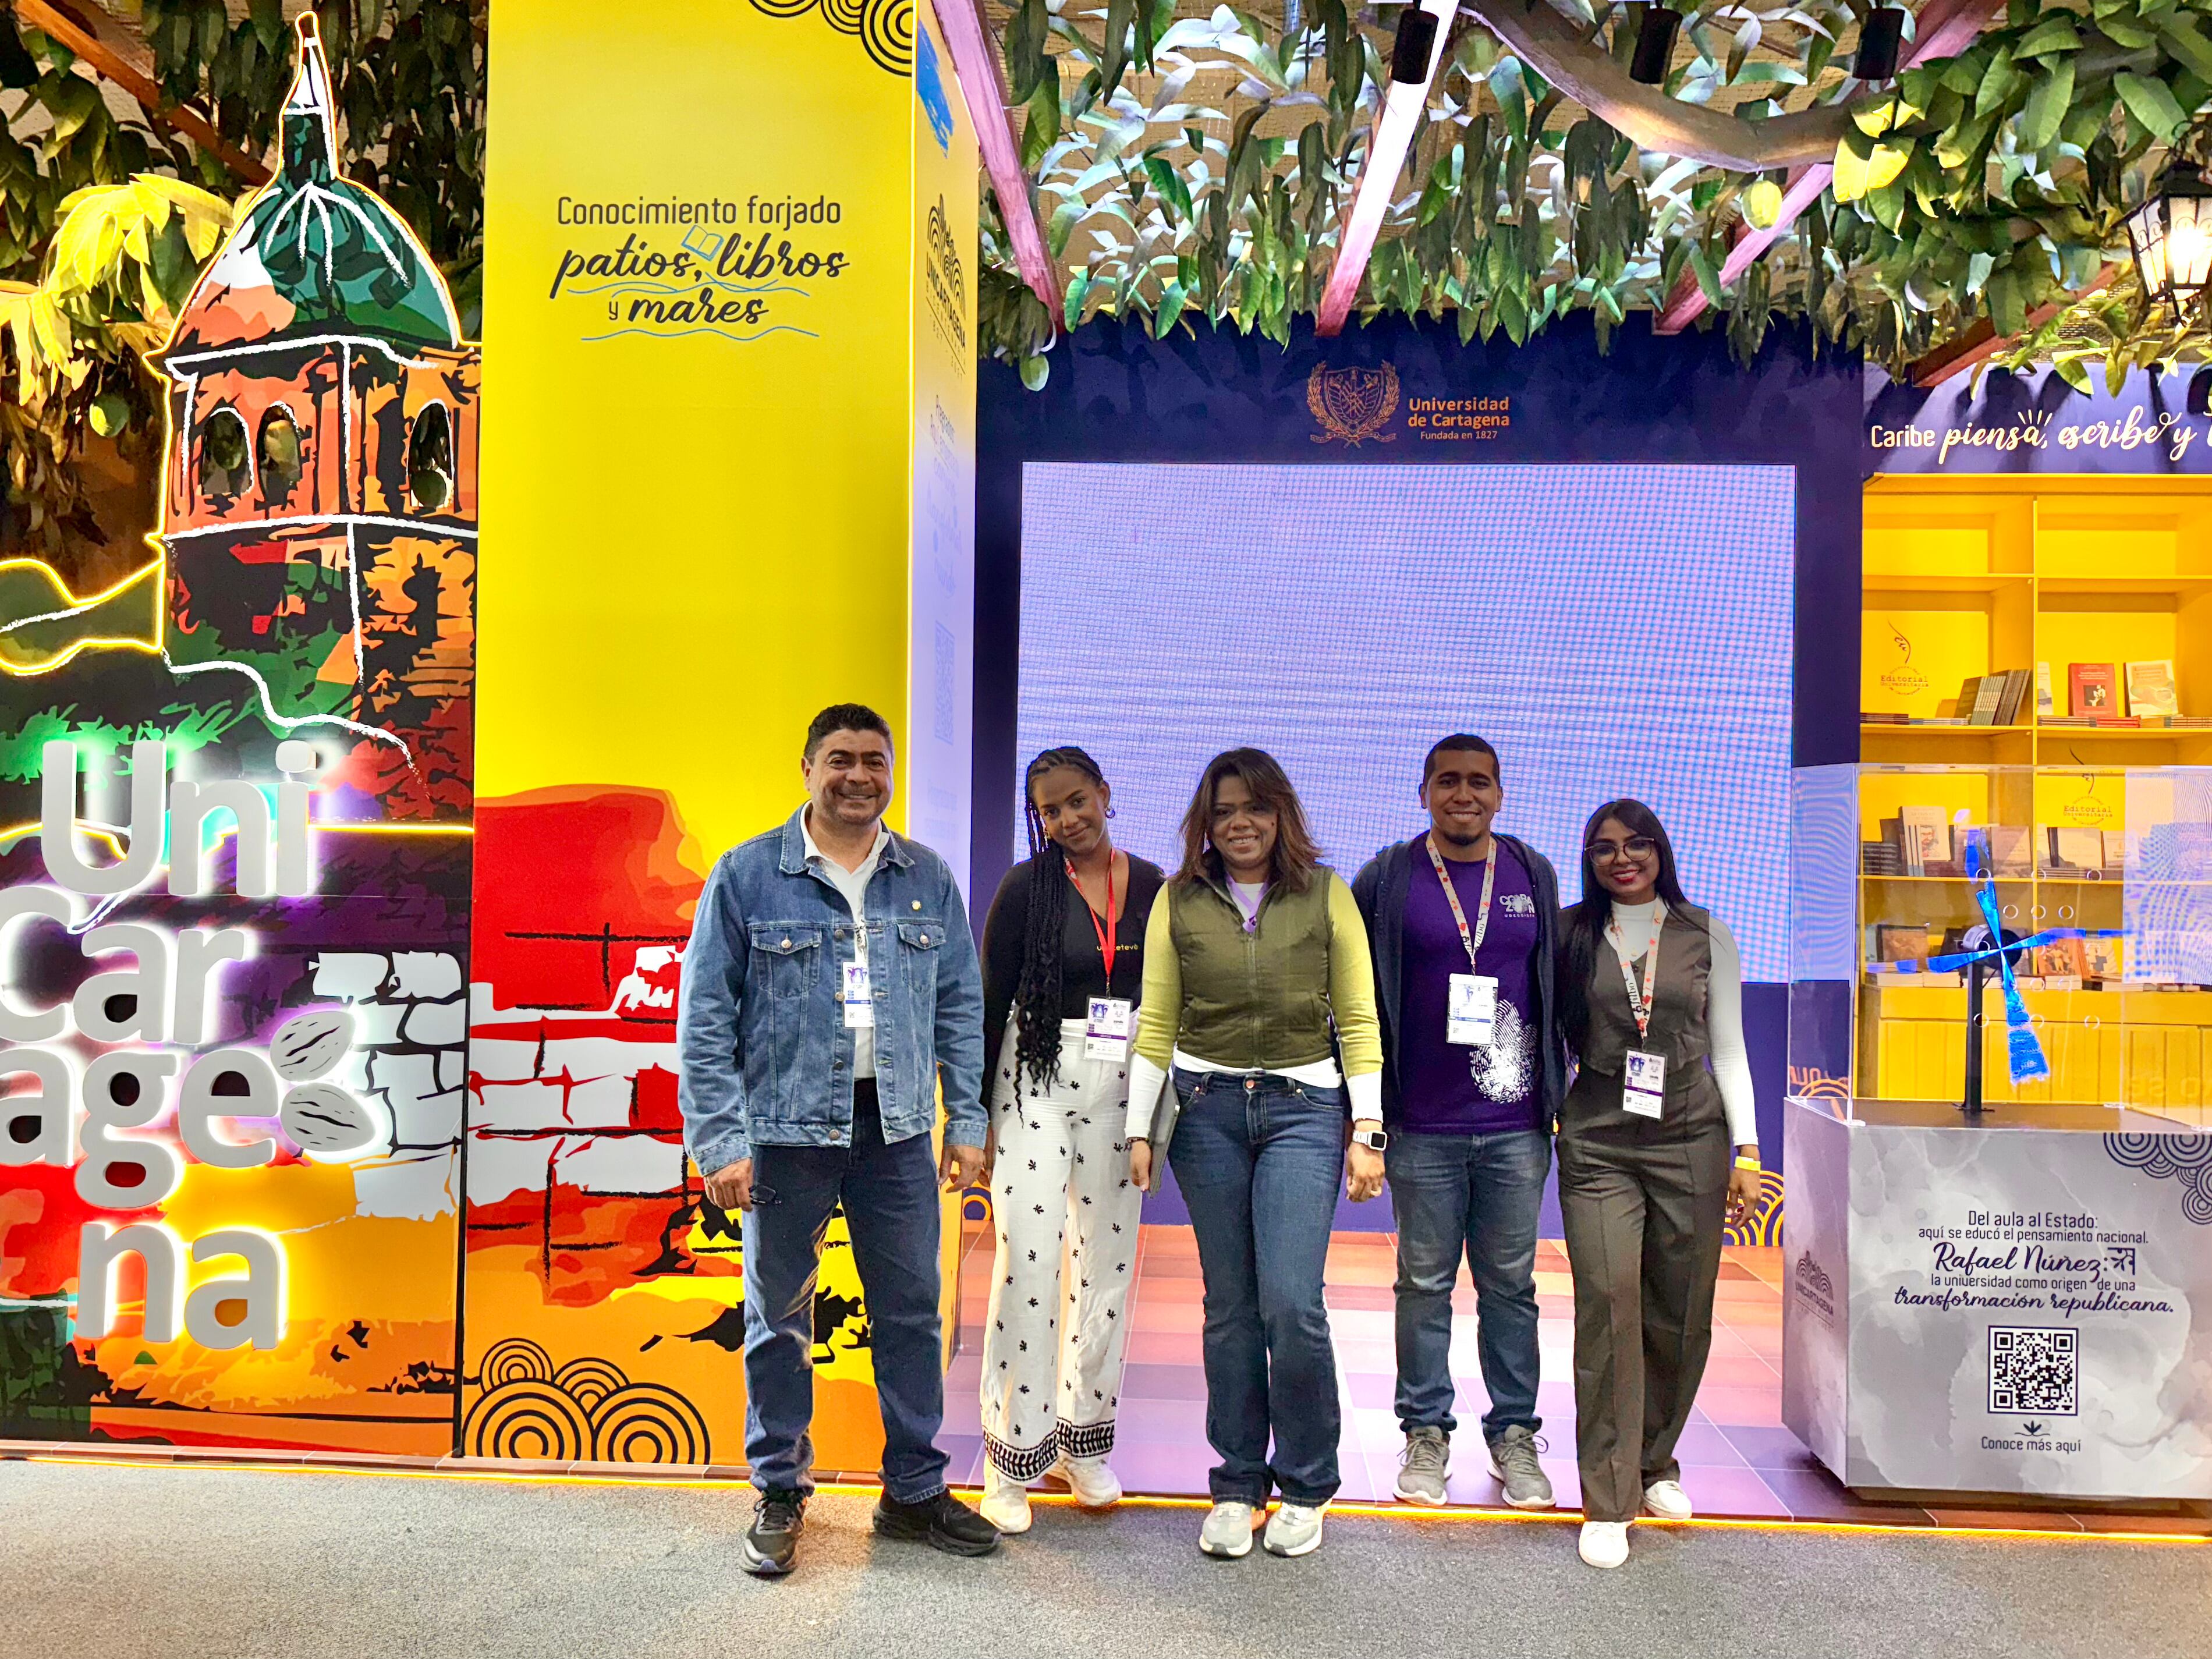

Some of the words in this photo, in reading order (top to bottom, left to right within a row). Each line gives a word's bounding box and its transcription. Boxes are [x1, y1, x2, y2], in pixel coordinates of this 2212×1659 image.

[558, 196, 737, 225] Conocimiento
[748, 194, 841, 231] forjado
[549, 233, 703, 299] patios,
[717, 232, 850, 280] libros
[608, 300, 619, 321] y
[628, 287, 770, 324] mares
[1409, 396, 1509, 411] Universidad
[1408, 414, 1426, 427] de
[1432, 413, 1509, 429] Cartagena
[1420, 431, 1458, 439] Fundada
[1476, 431, 1498, 439] 1827
[1871, 425, 1936, 447] Caribe
[1938, 421, 2048, 464] piensa,
[2058, 405, 2182, 450] escribe
[2169, 423, 2197, 461] y
[41, 740, 316, 896] Uni
[0, 886, 244, 1045] Car
[1919, 1225, 1944, 1241] aquí
[1948, 1229, 1962, 1239] se
[1966, 1227, 2000, 1239] educó
[2004, 1228, 2014, 1240] el
[2017, 1229, 2093, 1243] pensamiento
[2097, 1231, 2149, 1243] nacional.
[1969, 1210, 1989, 1226] Del
[1994, 1211, 2023, 1226] aula
[2029, 1212, 2040, 1227] al
[2046, 1212, 2098, 1228] Estado:
[1933, 1242, 2018, 1275] Rafael
[2024, 1245, 2108, 1283] Núñez:
[74, 1222, 287, 1350] na
[1931, 1274, 1941, 1285] la
[1945, 1274, 2012, 1288] universidad
[2015, 1278, 2048, 1289] como
[2051, 1277, 2087, 1292] origen
[2097, 1278, 2111, 1291] de
[2115, 1281, 2136, 1291] una
[1894, 1286, 2044, 1311] transformación
[2050, 1291, 2174, 1318] republicana.
[1981, 1436, 2023, 1450] Conoce
[2027, 1438, 2052, 1451] más
[2056, 1440, 2082, 1455] aquí
